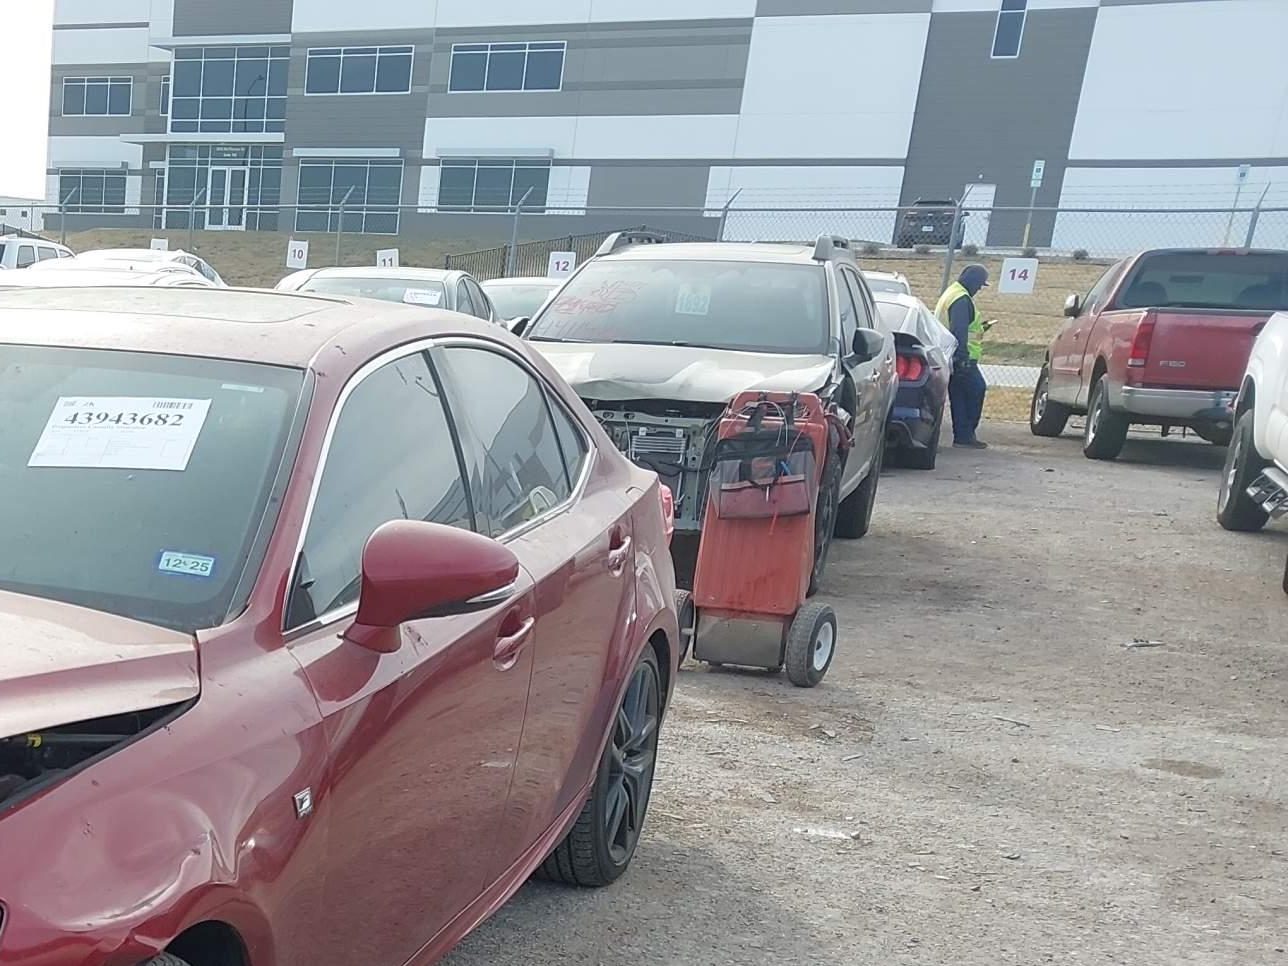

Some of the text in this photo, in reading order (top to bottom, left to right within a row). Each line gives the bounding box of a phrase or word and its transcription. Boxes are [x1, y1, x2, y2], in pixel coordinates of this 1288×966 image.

[292, 249, 304, 260] 10
[381, 257, 393, 267] 11
[555, 261, 570, 272] 12
[1009, 268, 1029, 281] 14
[63, 411, 185, 427] 43943682
[165, 558, 210, 572] 12 25
